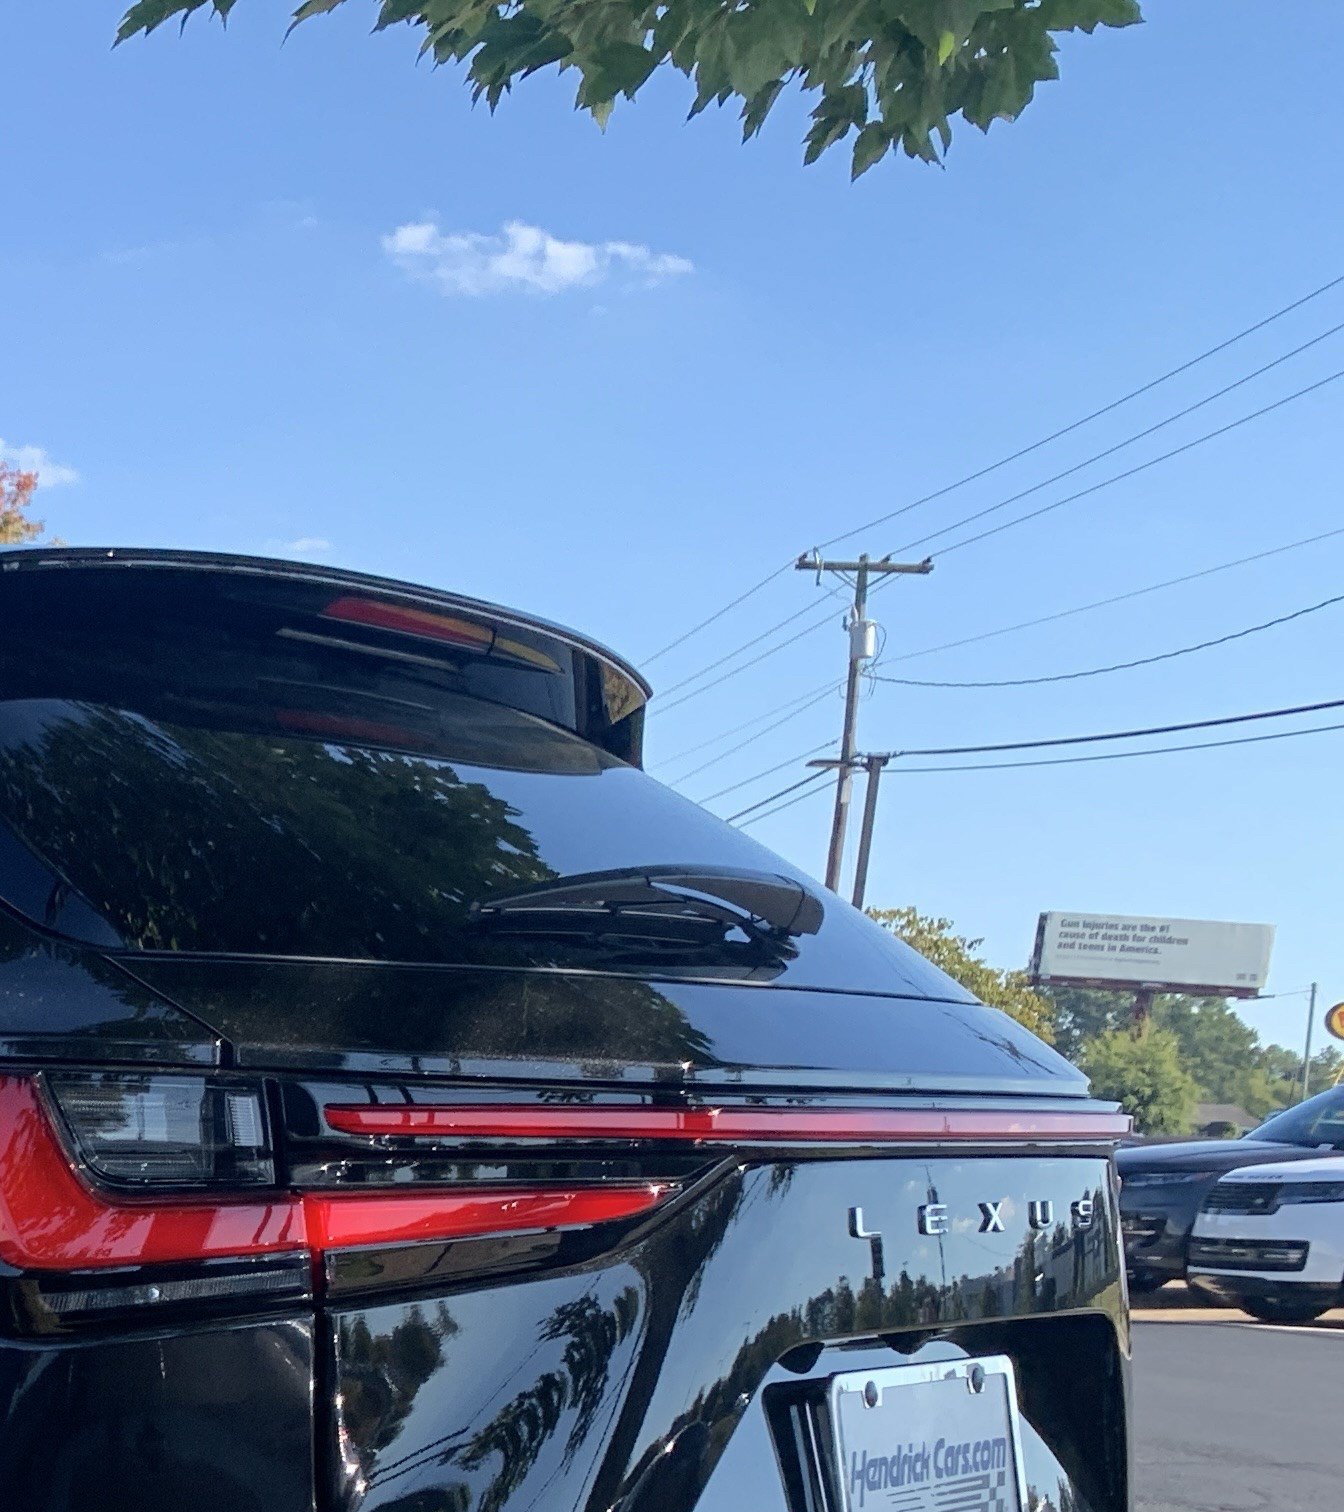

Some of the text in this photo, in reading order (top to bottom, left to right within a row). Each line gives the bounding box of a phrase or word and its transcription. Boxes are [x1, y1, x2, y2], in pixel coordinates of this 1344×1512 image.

[1061, 919, 1079, 928] Gun
[1122, 923, 1137, 931] are
[1140, 924, 1156, 932] the
[1059, 931, 1188, 945] cause of death for children
[1057, 941, 1075, 950] and
[1078, 943, 1105, 952] teens
[1107, 944, 1117, 952] in
[849, 1201, 1094, 1239] LEXUS
